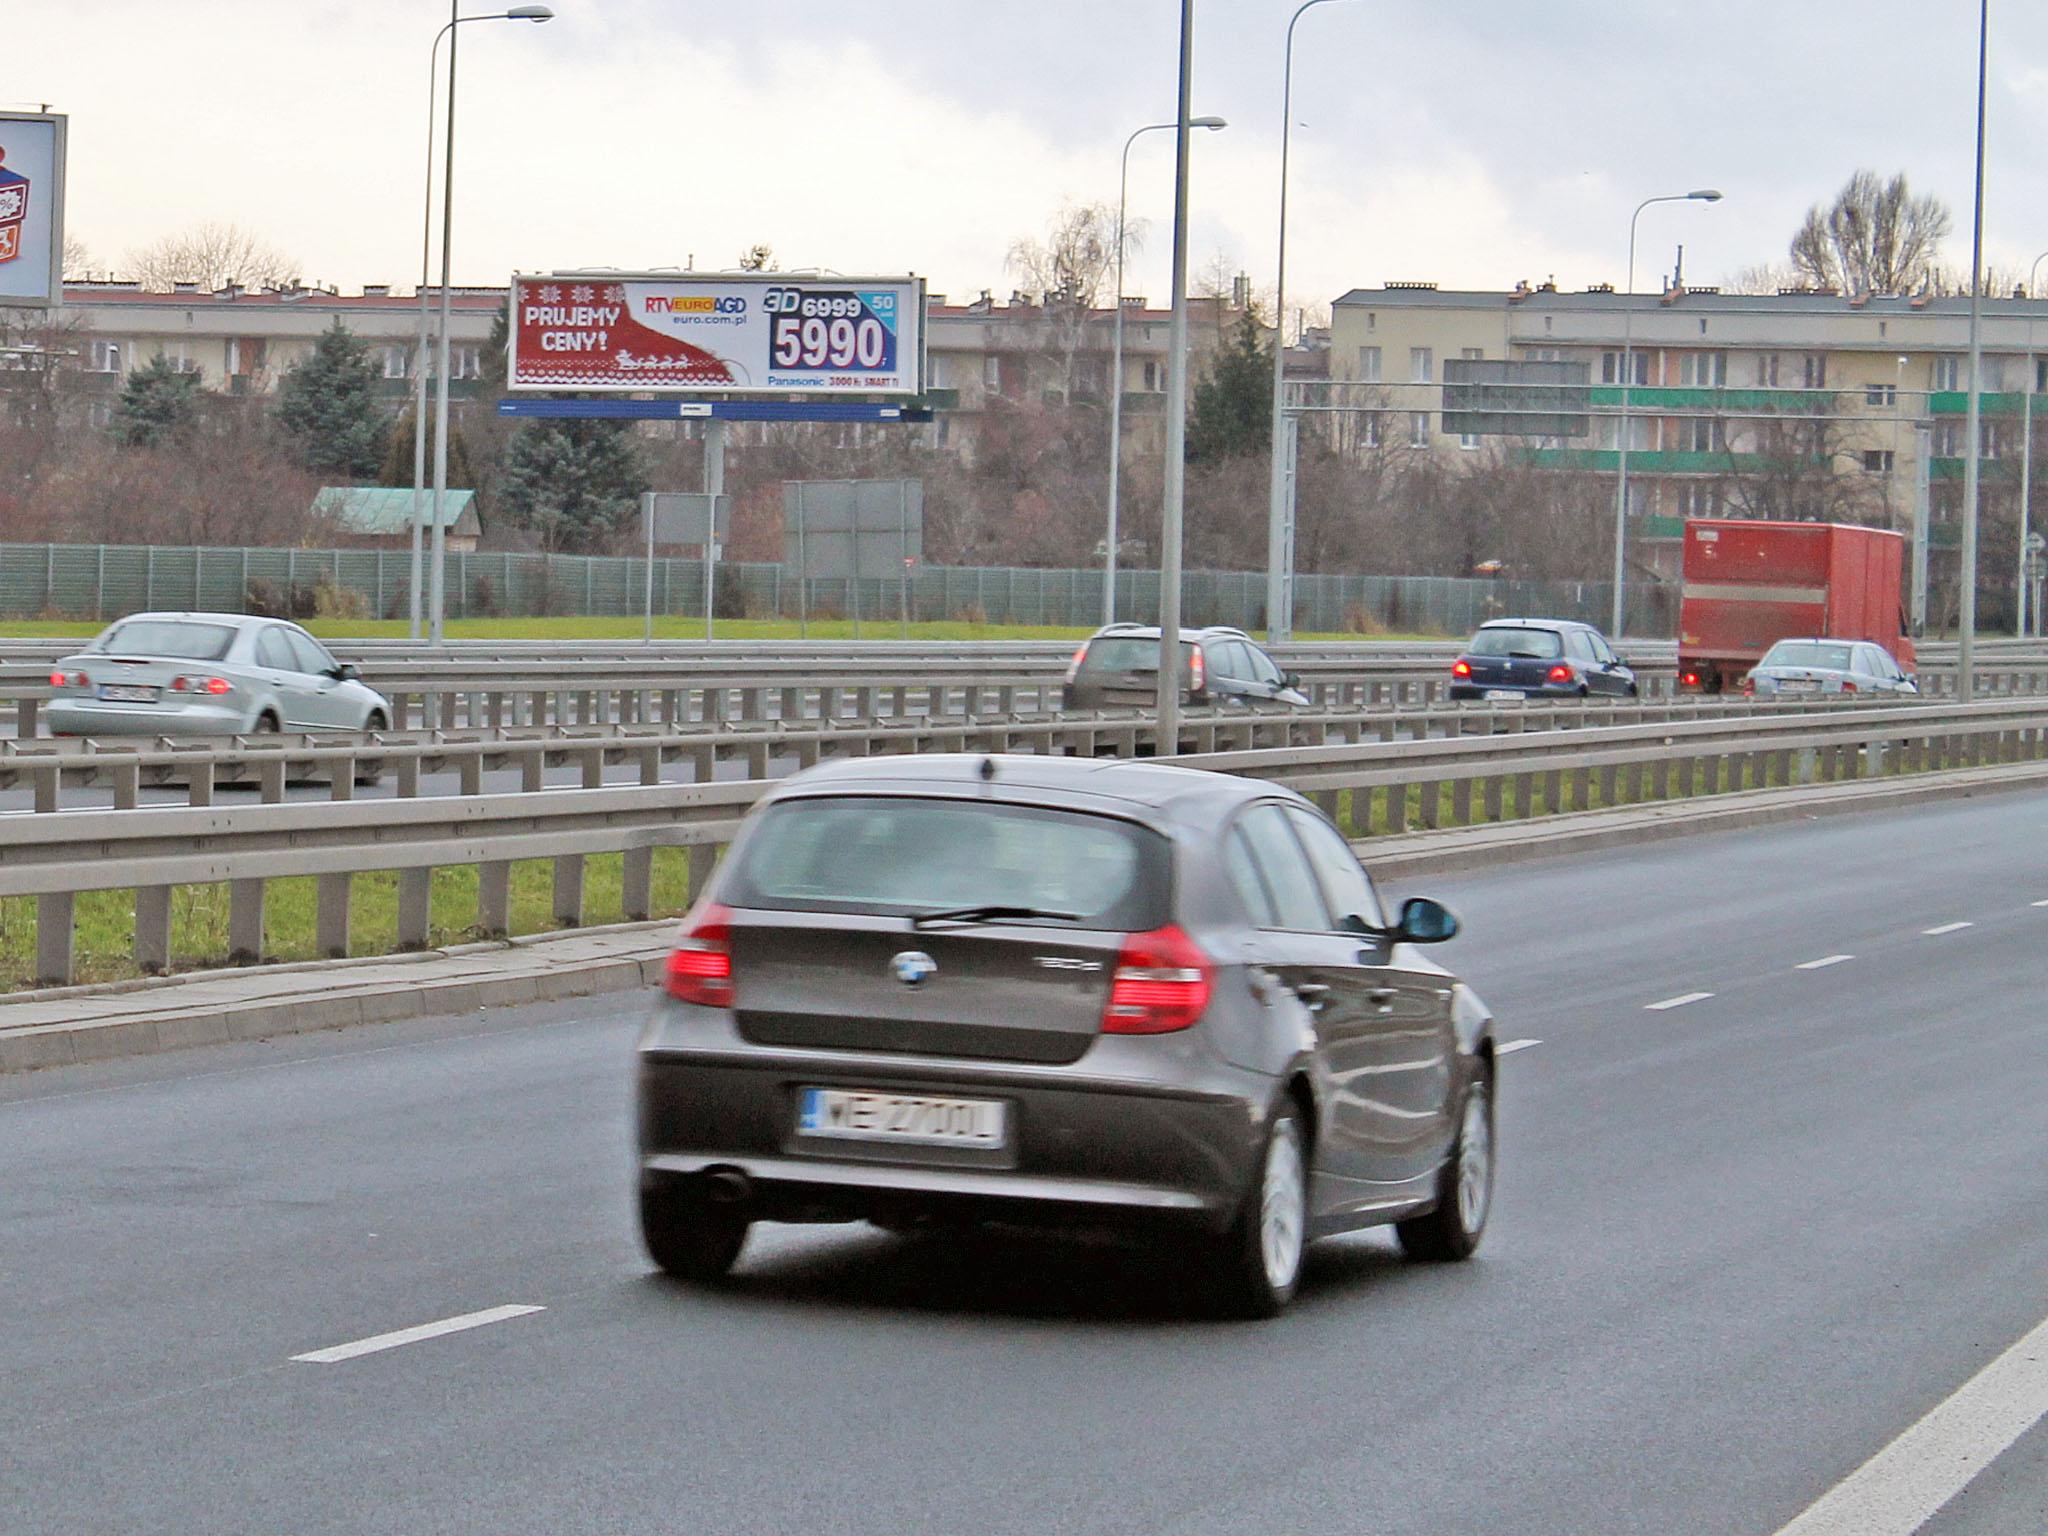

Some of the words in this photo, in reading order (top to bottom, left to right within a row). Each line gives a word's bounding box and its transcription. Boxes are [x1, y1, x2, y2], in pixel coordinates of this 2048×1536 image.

[763, 290, 800, 313] 3D
[802, 298, 862, 317] 6999
[872, 296, 893, 309] 50
[525, 306, 620, 326] PRUJEMY
[673, 315, 747, 325] euro.com.pl
[541, 330, 608, 351] CENY!
[775, 318, 883, 367] 5990
[768, 376, 824, 386] Panasonic
